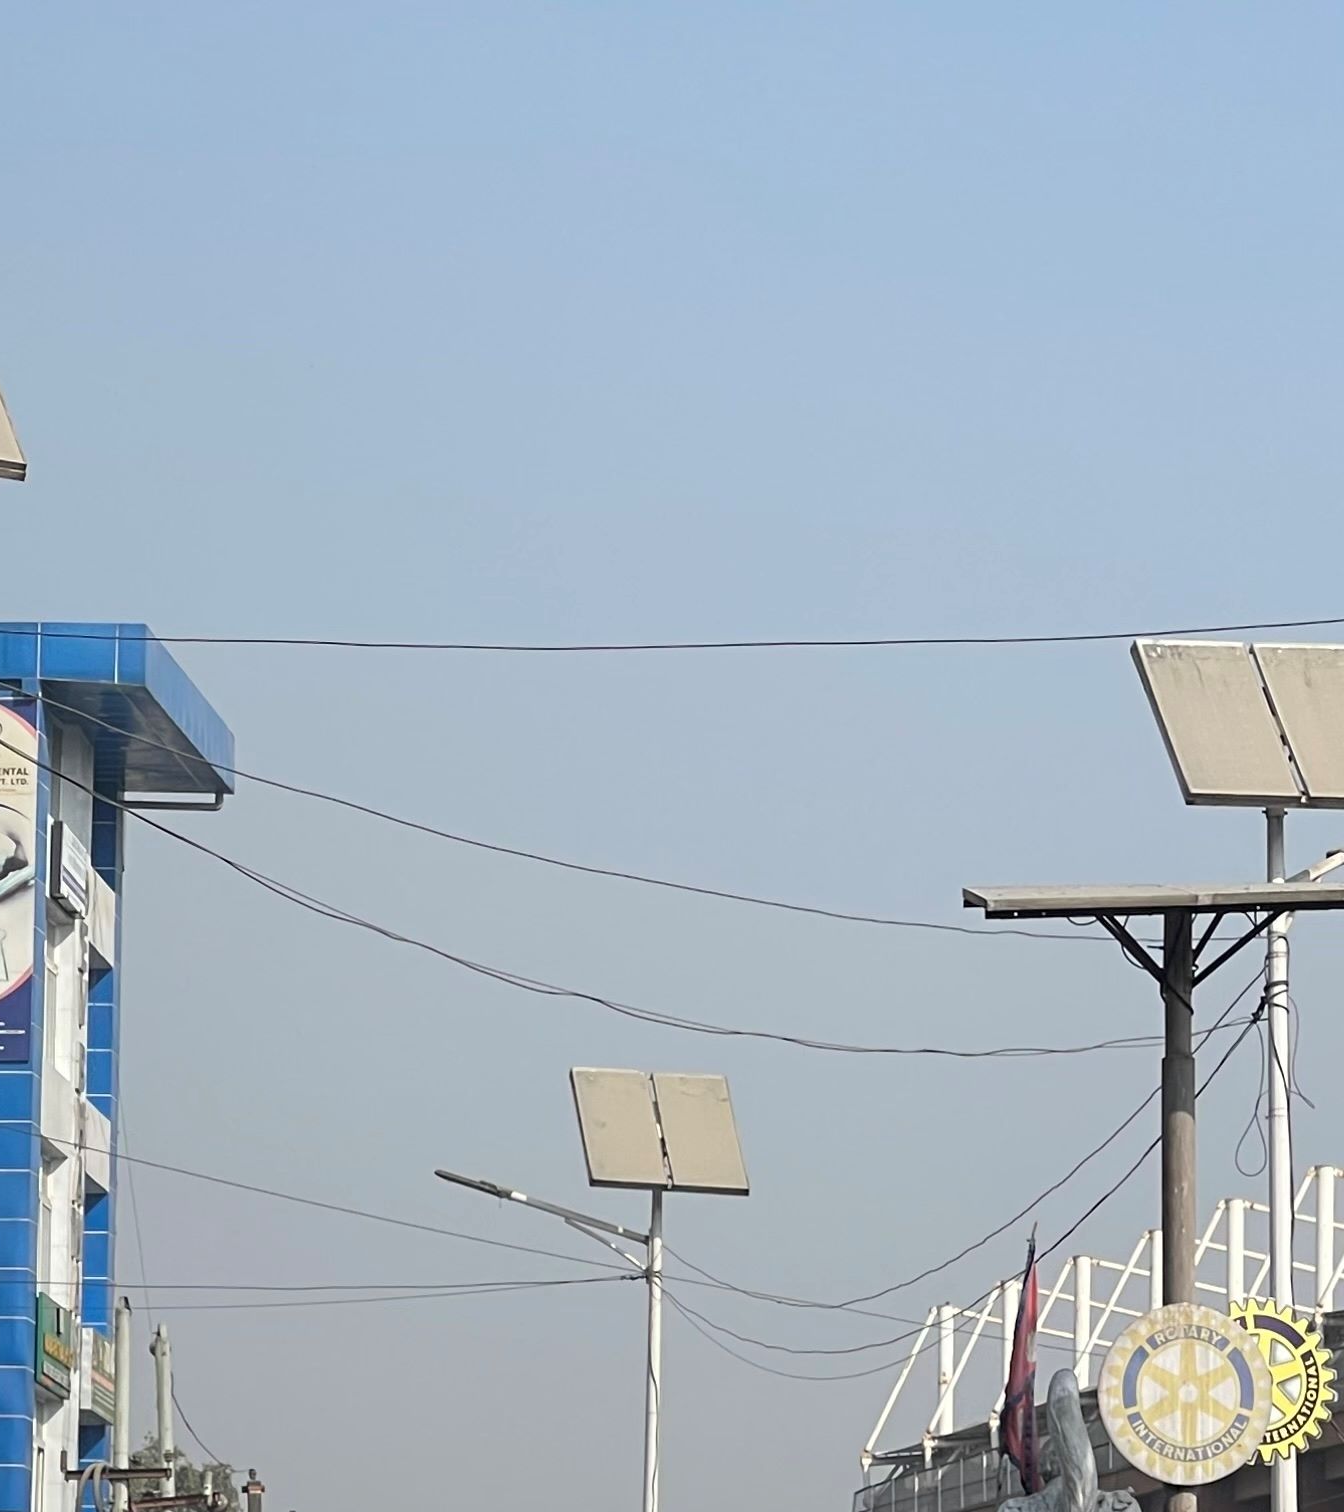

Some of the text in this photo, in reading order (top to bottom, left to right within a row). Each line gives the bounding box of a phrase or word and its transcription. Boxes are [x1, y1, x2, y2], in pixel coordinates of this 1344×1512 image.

[1153, 1324, 1224, 1347] ROTARY
[1259, 1352, 1321, 1445] TERNATIONAL
[1131, 1414, 1248, 1462] INTERNATIONAL
